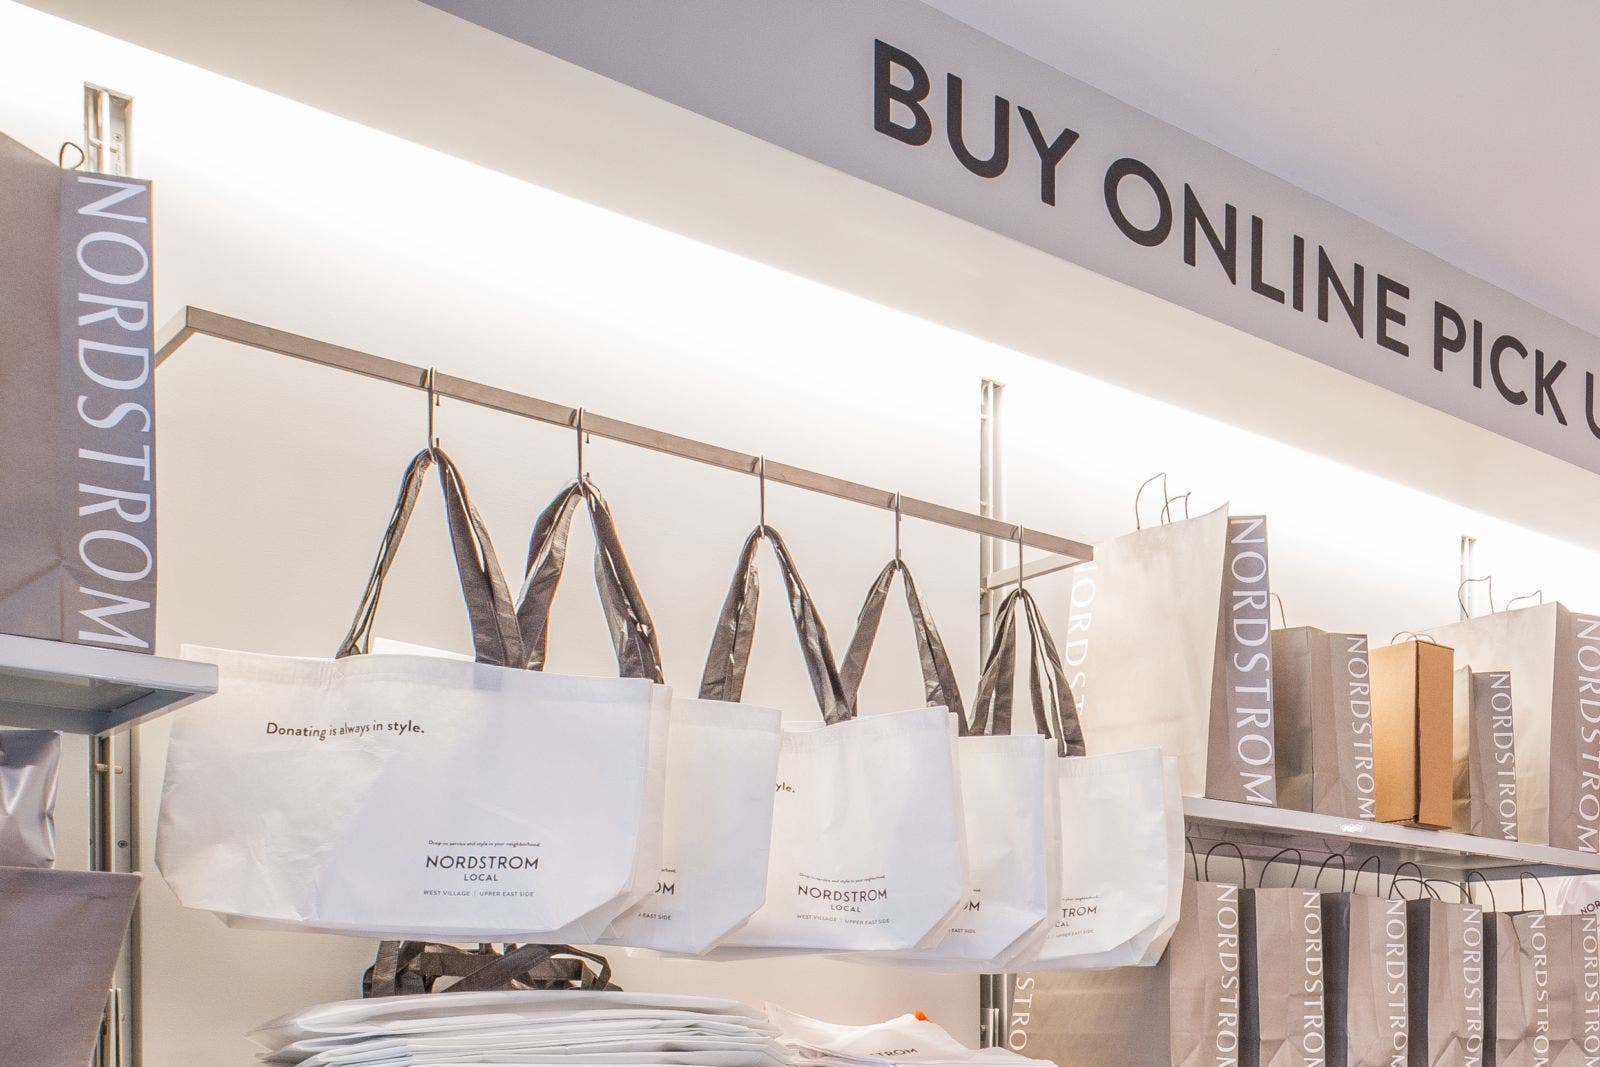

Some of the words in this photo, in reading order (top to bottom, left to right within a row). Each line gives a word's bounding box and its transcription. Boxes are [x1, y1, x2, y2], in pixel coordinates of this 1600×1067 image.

[872, 38, 1080, 208] BUY
[1103, 156, 1410, 358] ONLINE
[1434, 301, 1569, 427] PICK
[76, 175, 153, 650] NORDSTROM
[1229, 516, 1275, 806] NORDSTROM
[266, 722, 326, 741] Donating
[329, 725, 337, 736] is
[339, 722, 370, 738] always
[373, 720, 383, 731] in
[387, 720, 425, 736] style.
[1346, 636, 1376, 820] NORDSTROM
[1489, 671, 1518, 842] NORDSTROM
[775, 782, 796, 793] yle.
[426, 855, 539, 870] NORDSTROM
[464, 873, 498, 882] LOCAL
[798, 885, 887, 903] NORDSTROM
[831, 904, 861, 913] LOCAL
